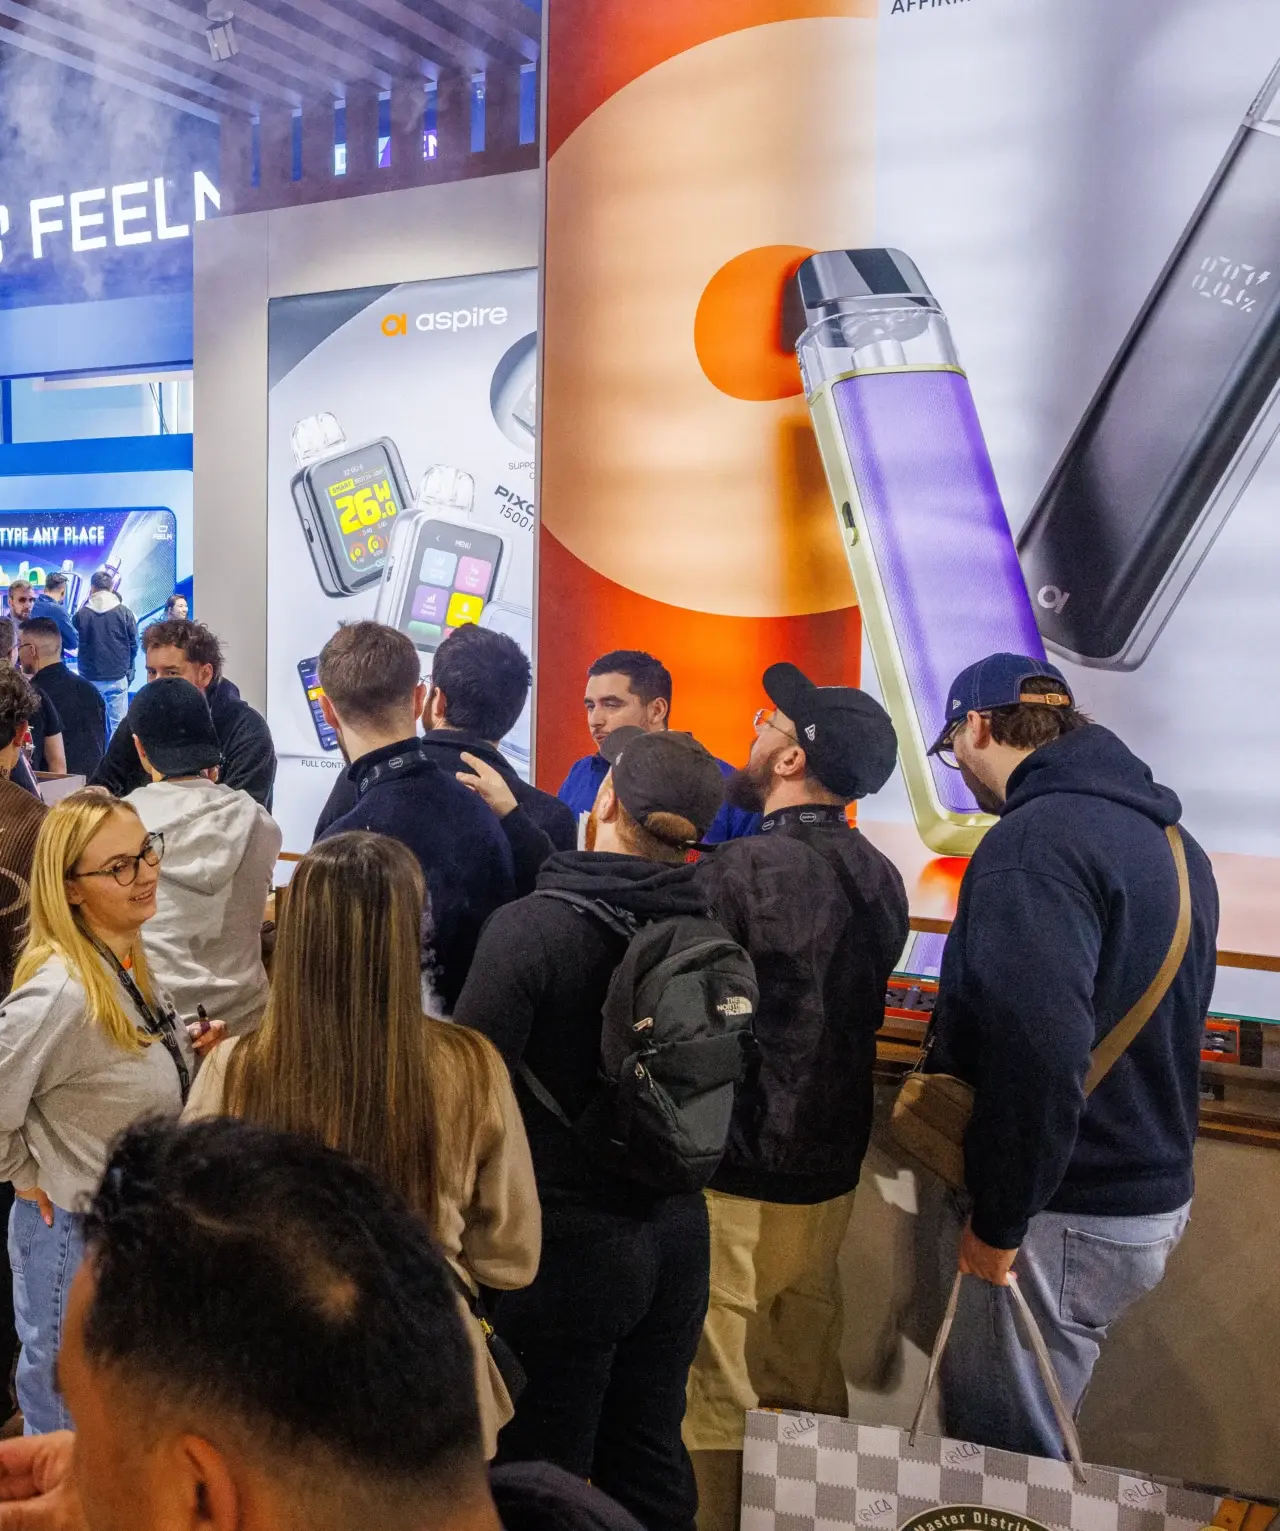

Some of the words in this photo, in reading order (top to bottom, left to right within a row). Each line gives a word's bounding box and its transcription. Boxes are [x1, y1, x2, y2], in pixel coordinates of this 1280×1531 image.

[416, 306, 508, 332] aspire
[499, 504, 529, 528] 1500
[32, 526, 59, 542] ANY
[64, 525, 105, 542] PLACE
[455, 539, 472, 549] MENU
[301, 760, 320, 768] FULL
[726, 996, 741, 1004] THE
[792, 1417, 816, 1435] LCA
[957, 1443, 981, 1459] LCA
[1138, 1481, 1163, 1501] LCA
[869, 1499, 893, 1517] LCA
